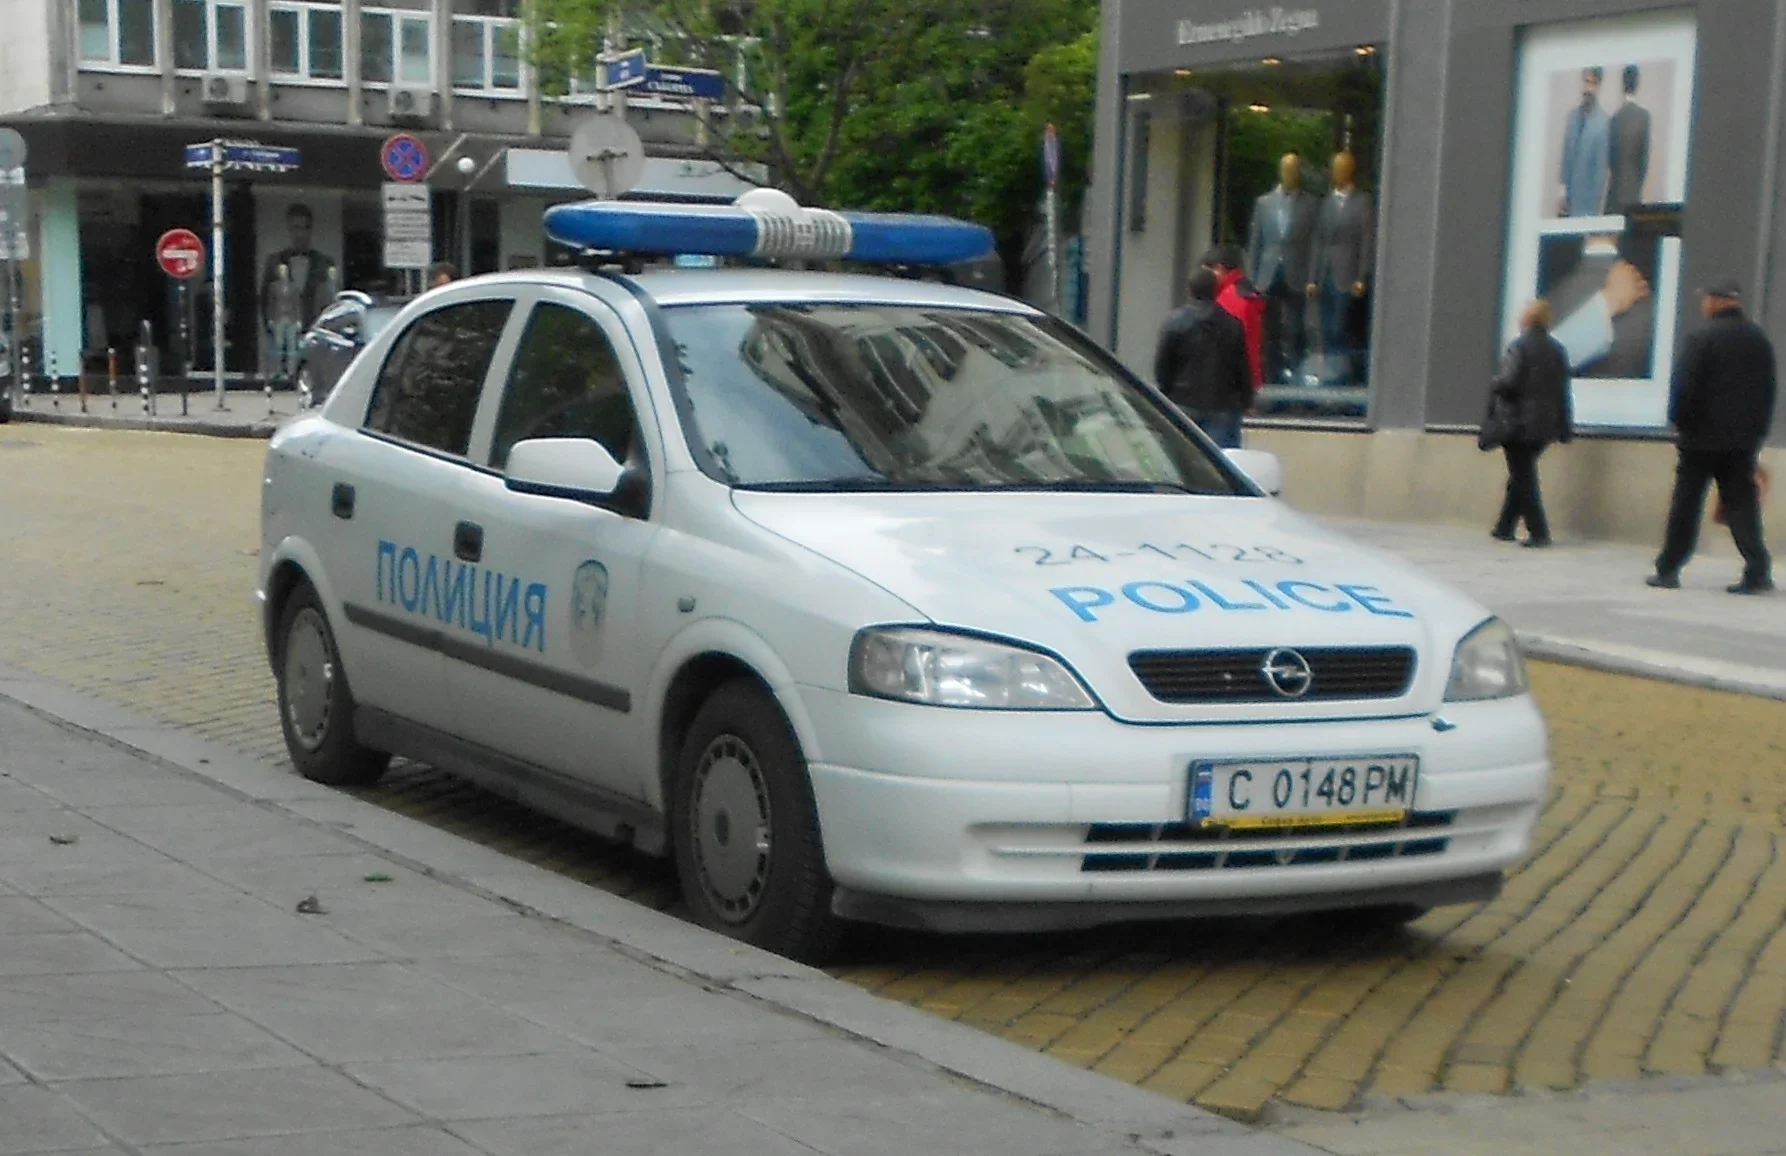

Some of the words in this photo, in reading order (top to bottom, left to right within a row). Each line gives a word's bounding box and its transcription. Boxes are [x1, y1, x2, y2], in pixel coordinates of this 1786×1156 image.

[1013, 542, 1304, 566] 24-1128
[377, 539, 547, 652] ПОЛИЦИЯ
[1048, 579, 1414, 622] POLICE
